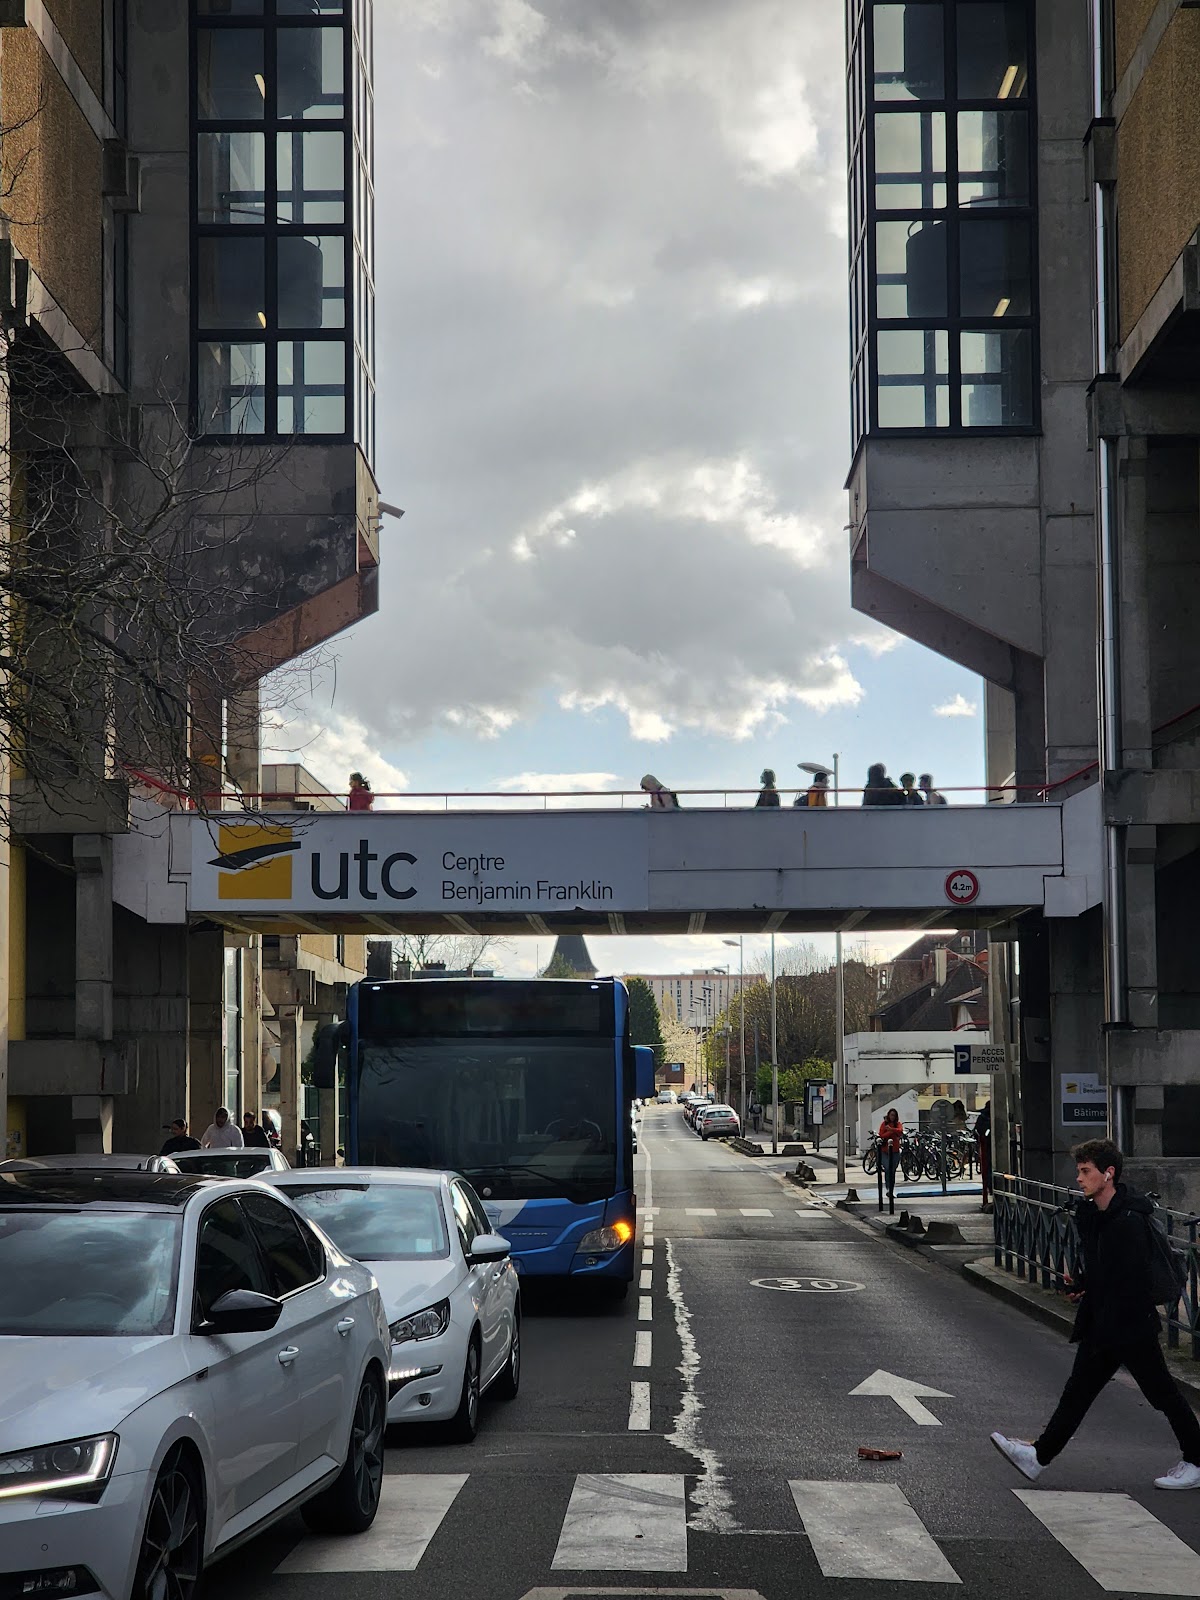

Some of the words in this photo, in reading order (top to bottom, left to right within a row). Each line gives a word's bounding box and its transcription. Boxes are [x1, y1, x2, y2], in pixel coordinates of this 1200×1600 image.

[311, 839, 418, 900] utc
[442, 851, 505, 871] Centre
[442, 880, 531, 905] Benjamin
[536, 880, 613, 900] Franklin
[952, 882, 972, 891] 4.2m
[956, 1051, 970, 1068] P
[981, 1048, 1005, 1056] ACCES
[777, 1279, 838, 1290] 30
